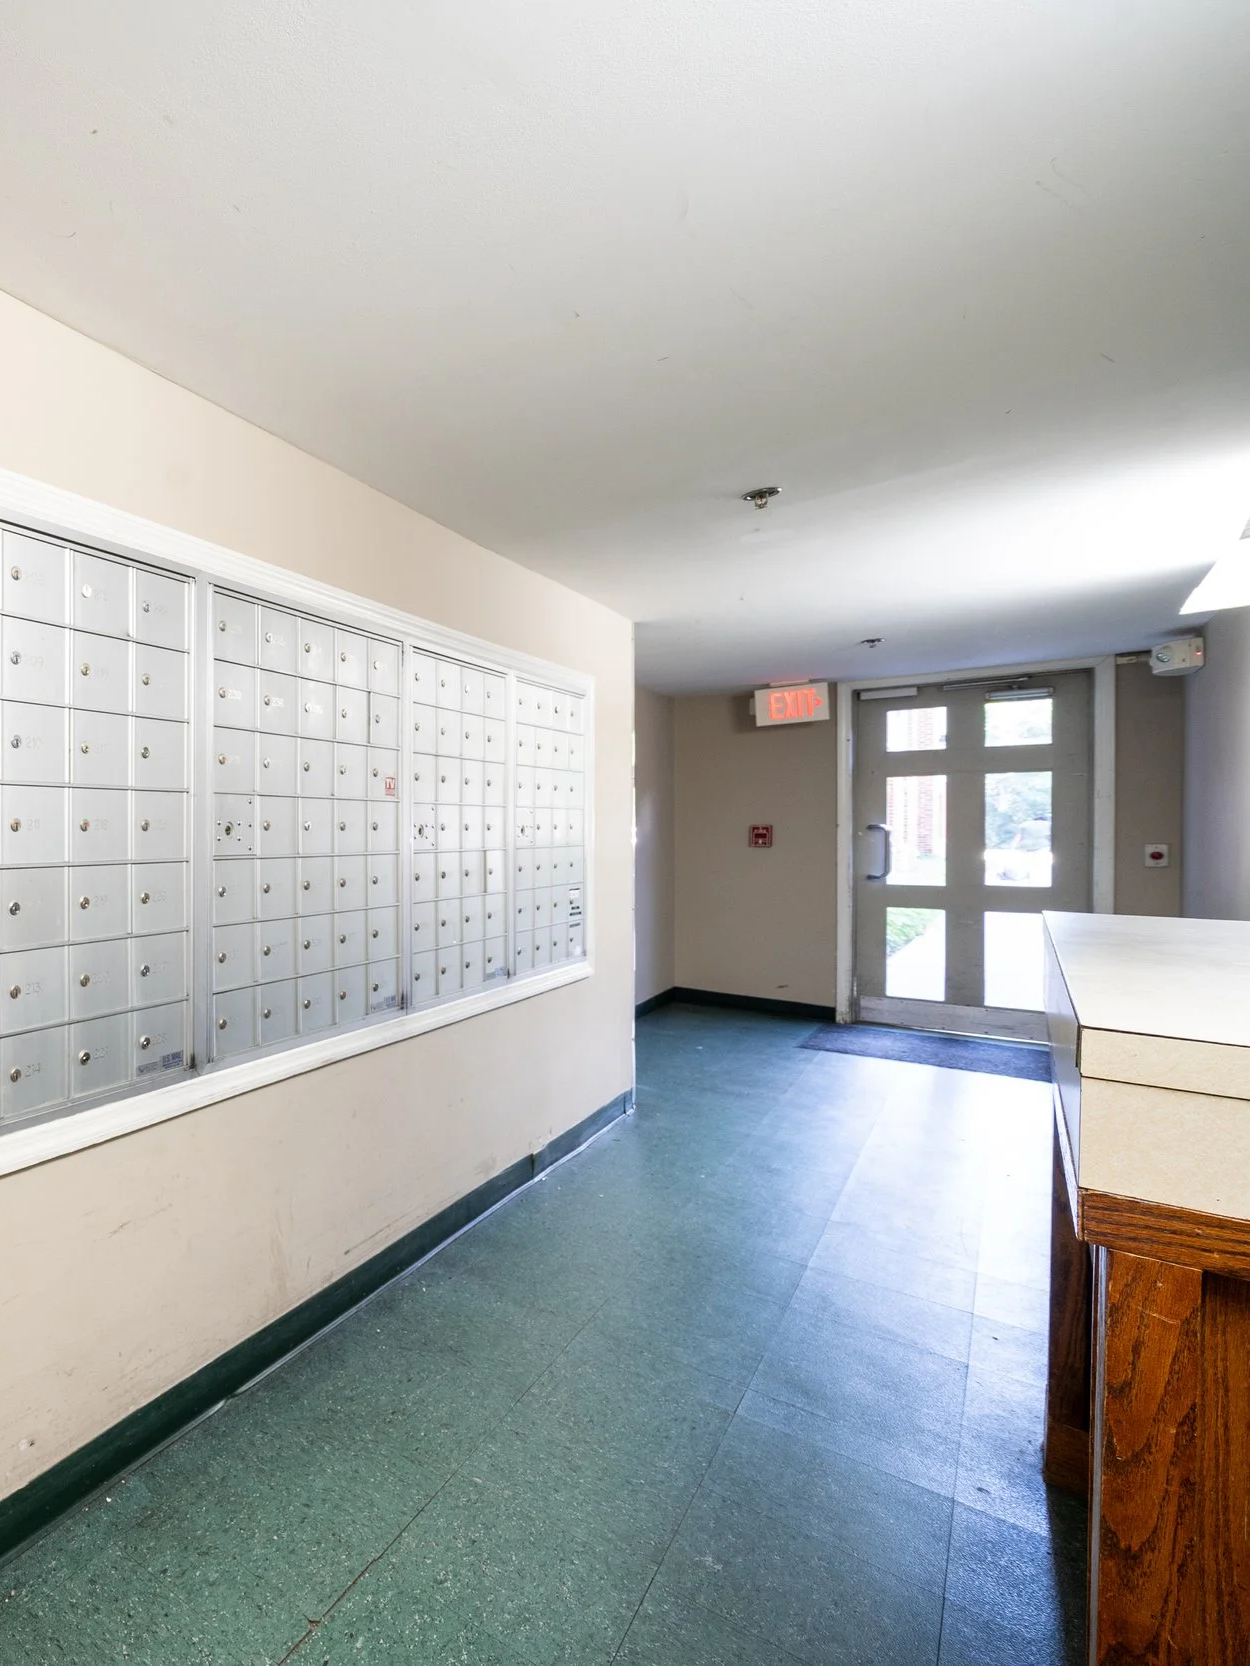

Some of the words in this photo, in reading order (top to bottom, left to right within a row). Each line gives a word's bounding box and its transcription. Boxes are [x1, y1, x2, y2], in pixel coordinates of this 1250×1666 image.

[769, 688, 816, 720] EXIT
[25, 982, 41, 995] 213
[24, 1063, 40, 1078] 214
